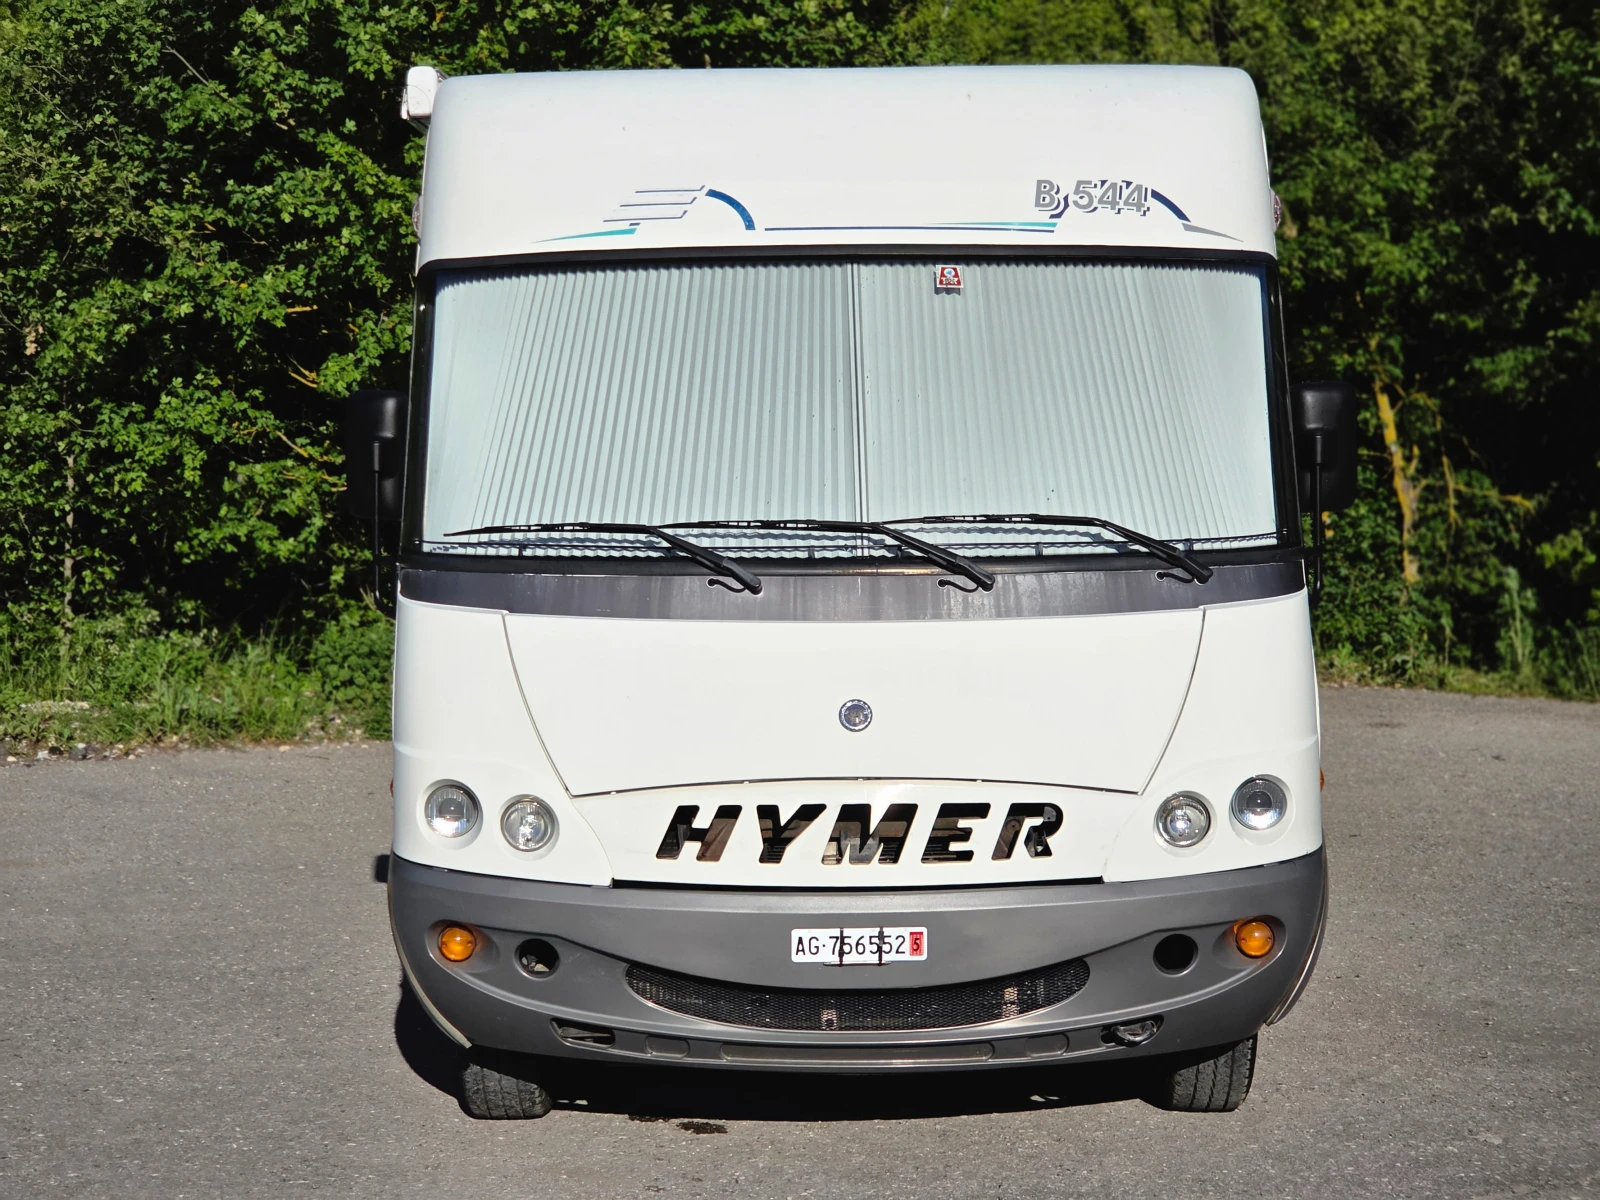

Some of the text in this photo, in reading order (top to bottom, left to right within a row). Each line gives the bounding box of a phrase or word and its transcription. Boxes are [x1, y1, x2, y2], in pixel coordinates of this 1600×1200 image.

[1034, 179, 1148, 214] B 544
[656, 803, 1064, 865] HYMER
[912, 936, 921, 952] 5
